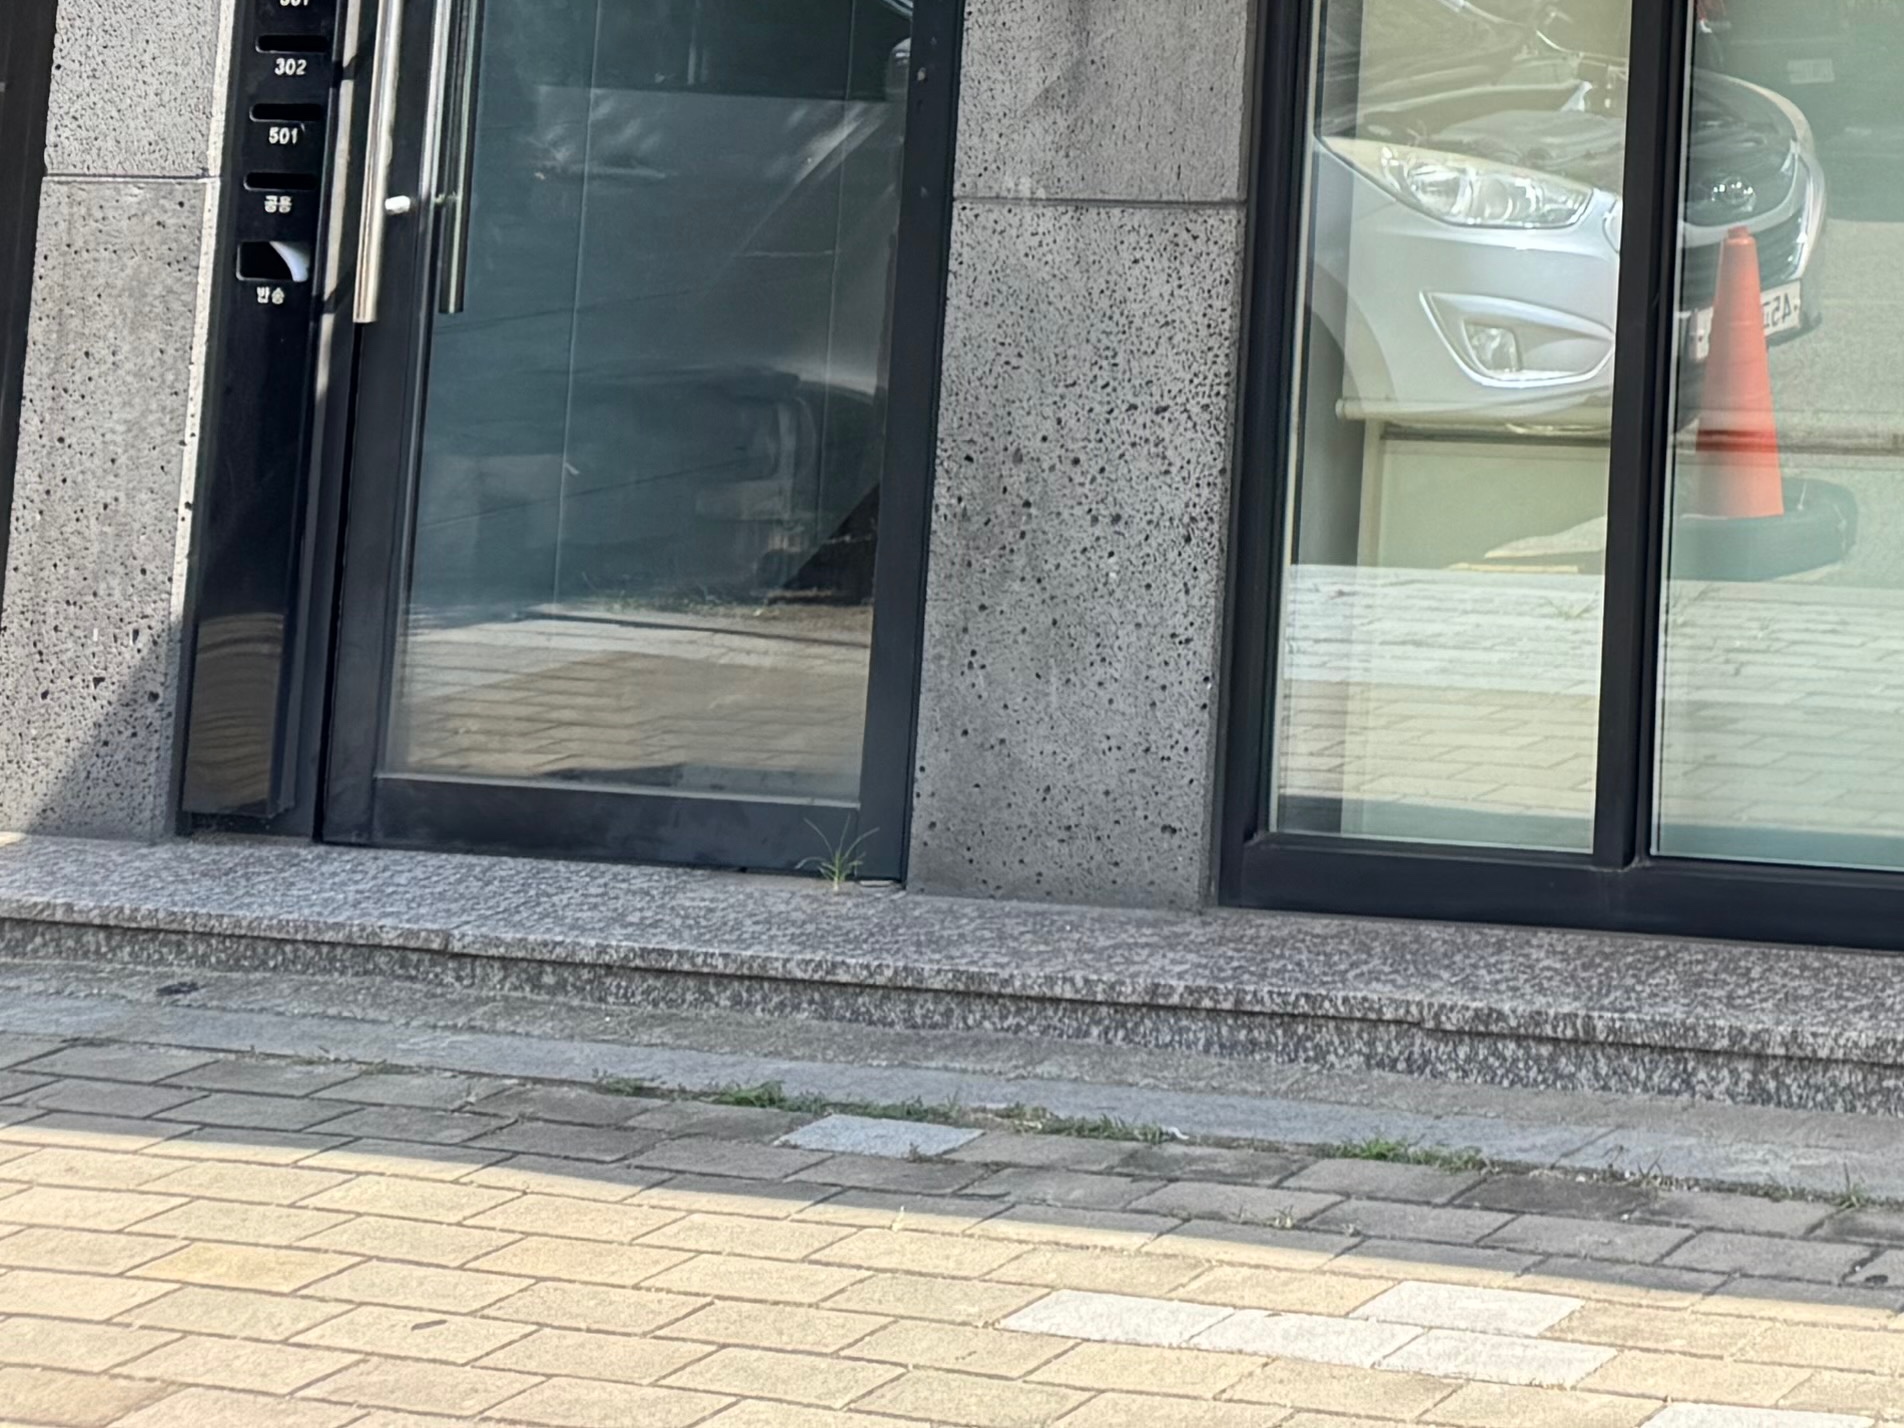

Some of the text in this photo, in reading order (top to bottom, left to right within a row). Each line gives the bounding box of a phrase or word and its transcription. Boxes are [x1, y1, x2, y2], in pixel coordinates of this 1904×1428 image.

[274, 57, 307, 76] 302
[268, 127, 298, 144] 501
[264, 195, 293, 214] 공용
[256, 286, 285, 305] 반송
